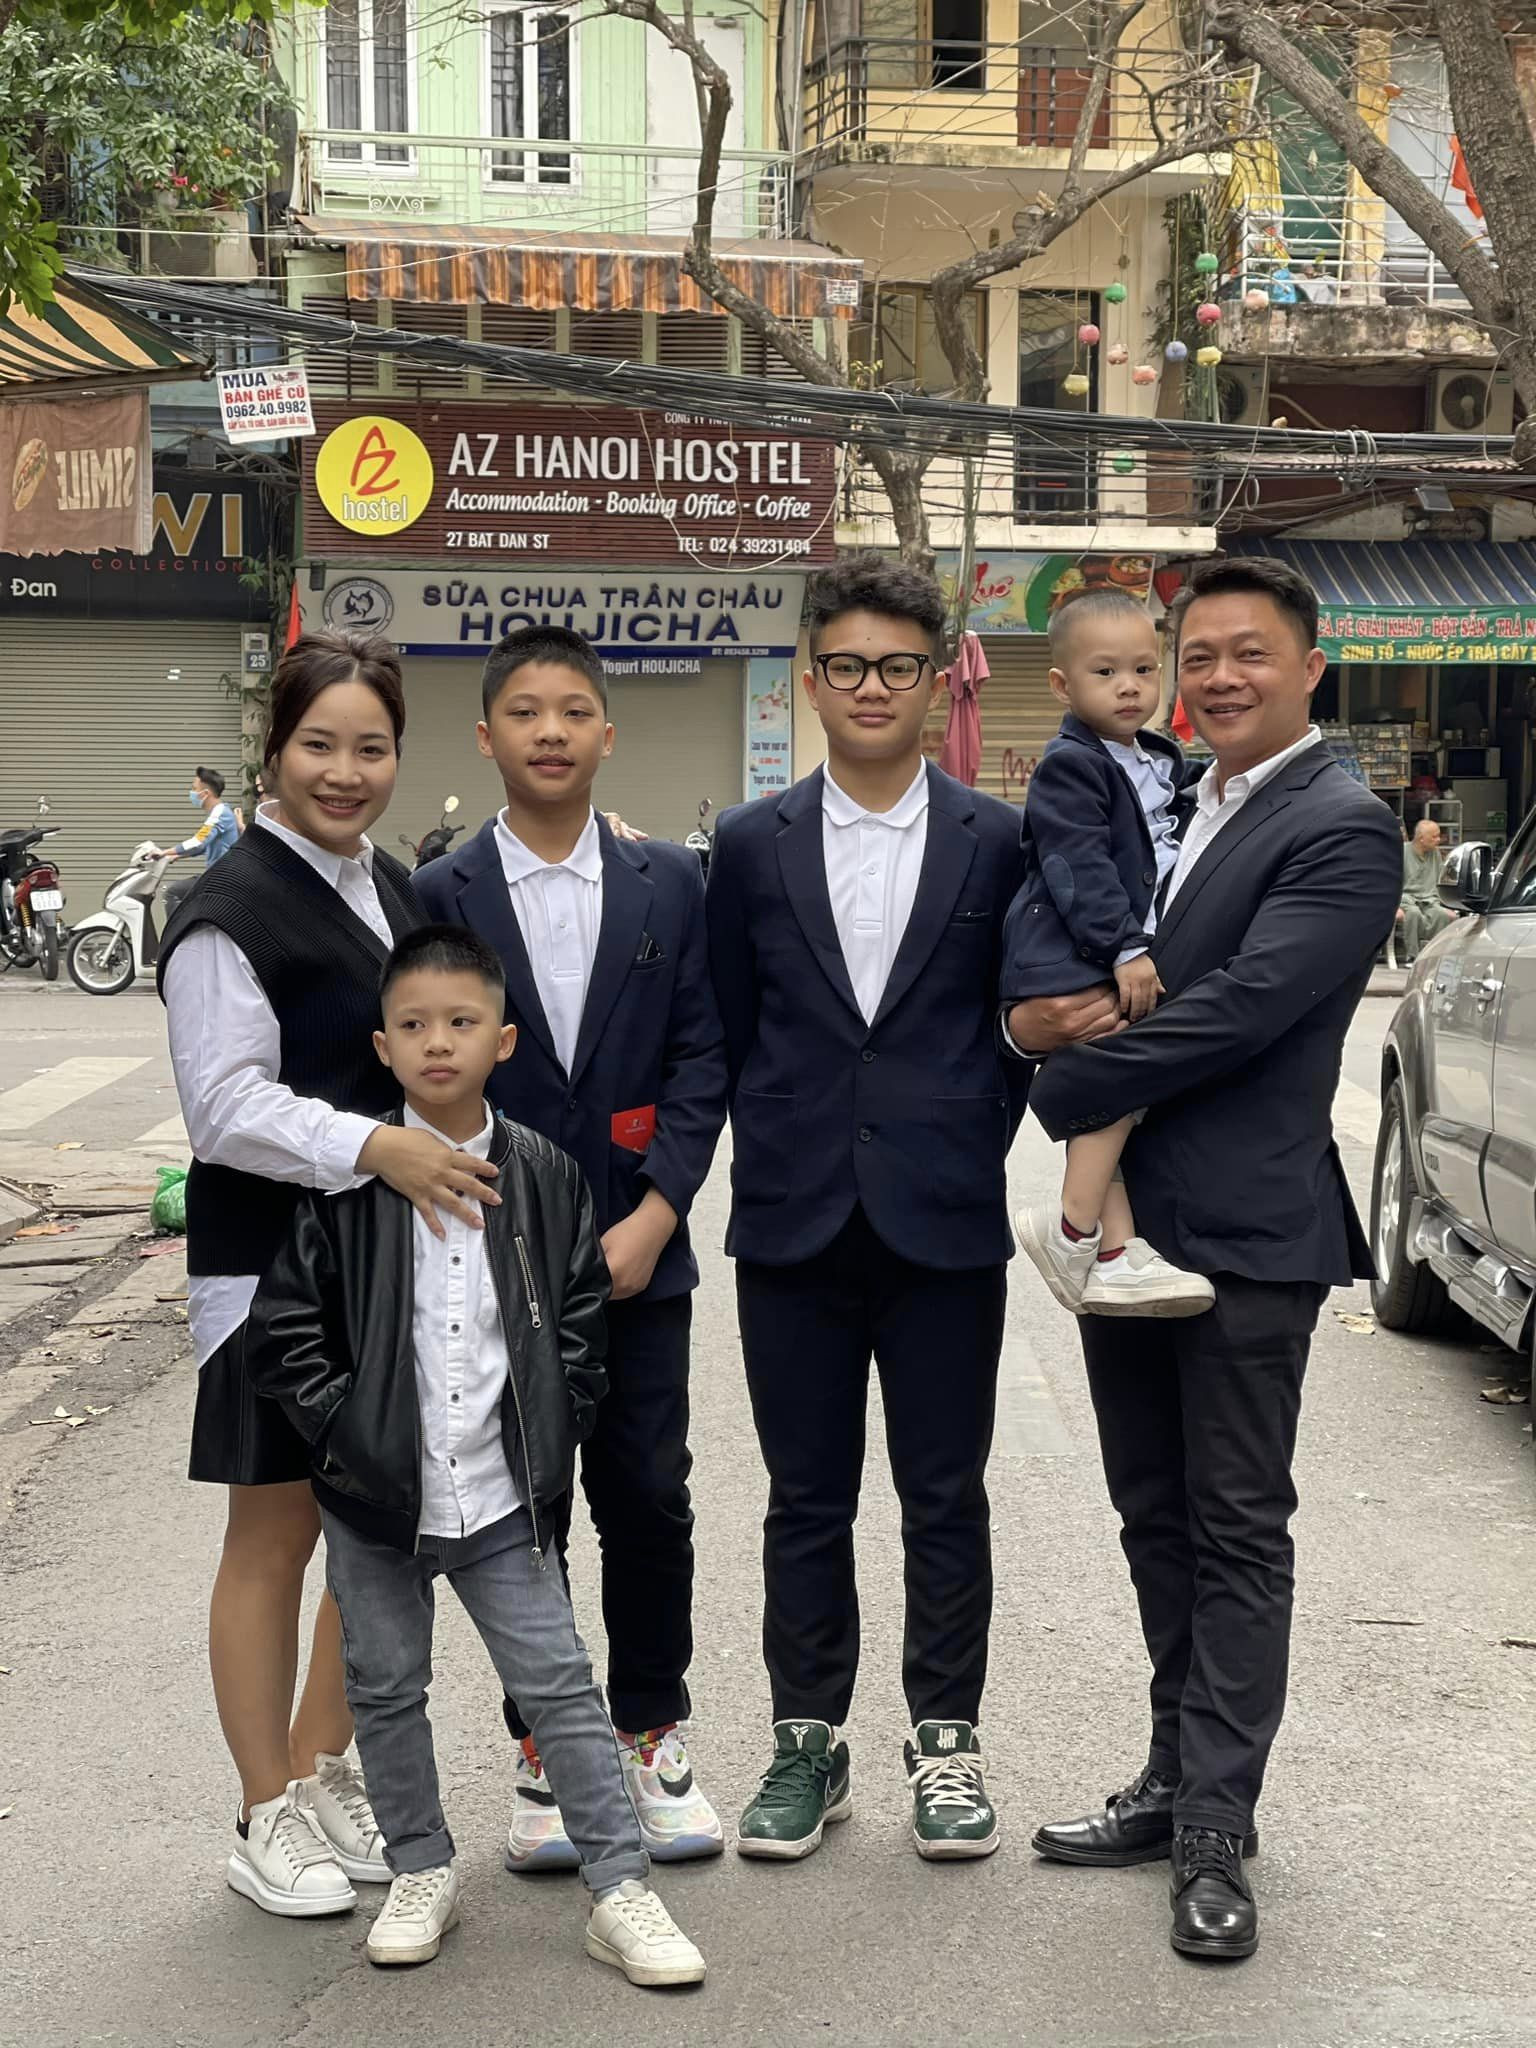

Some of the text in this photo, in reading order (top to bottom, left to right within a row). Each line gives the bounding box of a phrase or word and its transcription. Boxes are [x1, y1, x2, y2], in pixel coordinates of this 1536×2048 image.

[221, 372, 267, 389] MUA
[226, 400, 306, 418] 0962.40.9982
[448, 433, 811, 485] AZ HANOI HOSTEL
[342, 494, 408, 521] hostel
[445, 487, 590, 513] Accommodation
[606, 491, 677, 518] Booking
[684, 494, 736, 520] Office
[755, 495, 811, 520] Coffee
[446, 531, 550, 549] 27 BAT DAN ST
[677, 536, 811, 554] TEL: 024 39231484
[91, 558, 244, 573] COLLECTION
[10, 578, 57, 597] Đan
[423, 579, 488, 606] SỮA
[500, 586, 587, 608] CHUA
[600, 582, 686, 609] TRÂN
[696, 582, 783, 609] CHÂU
[250, 654, 266, 668] 25
[601, 659, 701, 676] Yogurt HOUJICHA
